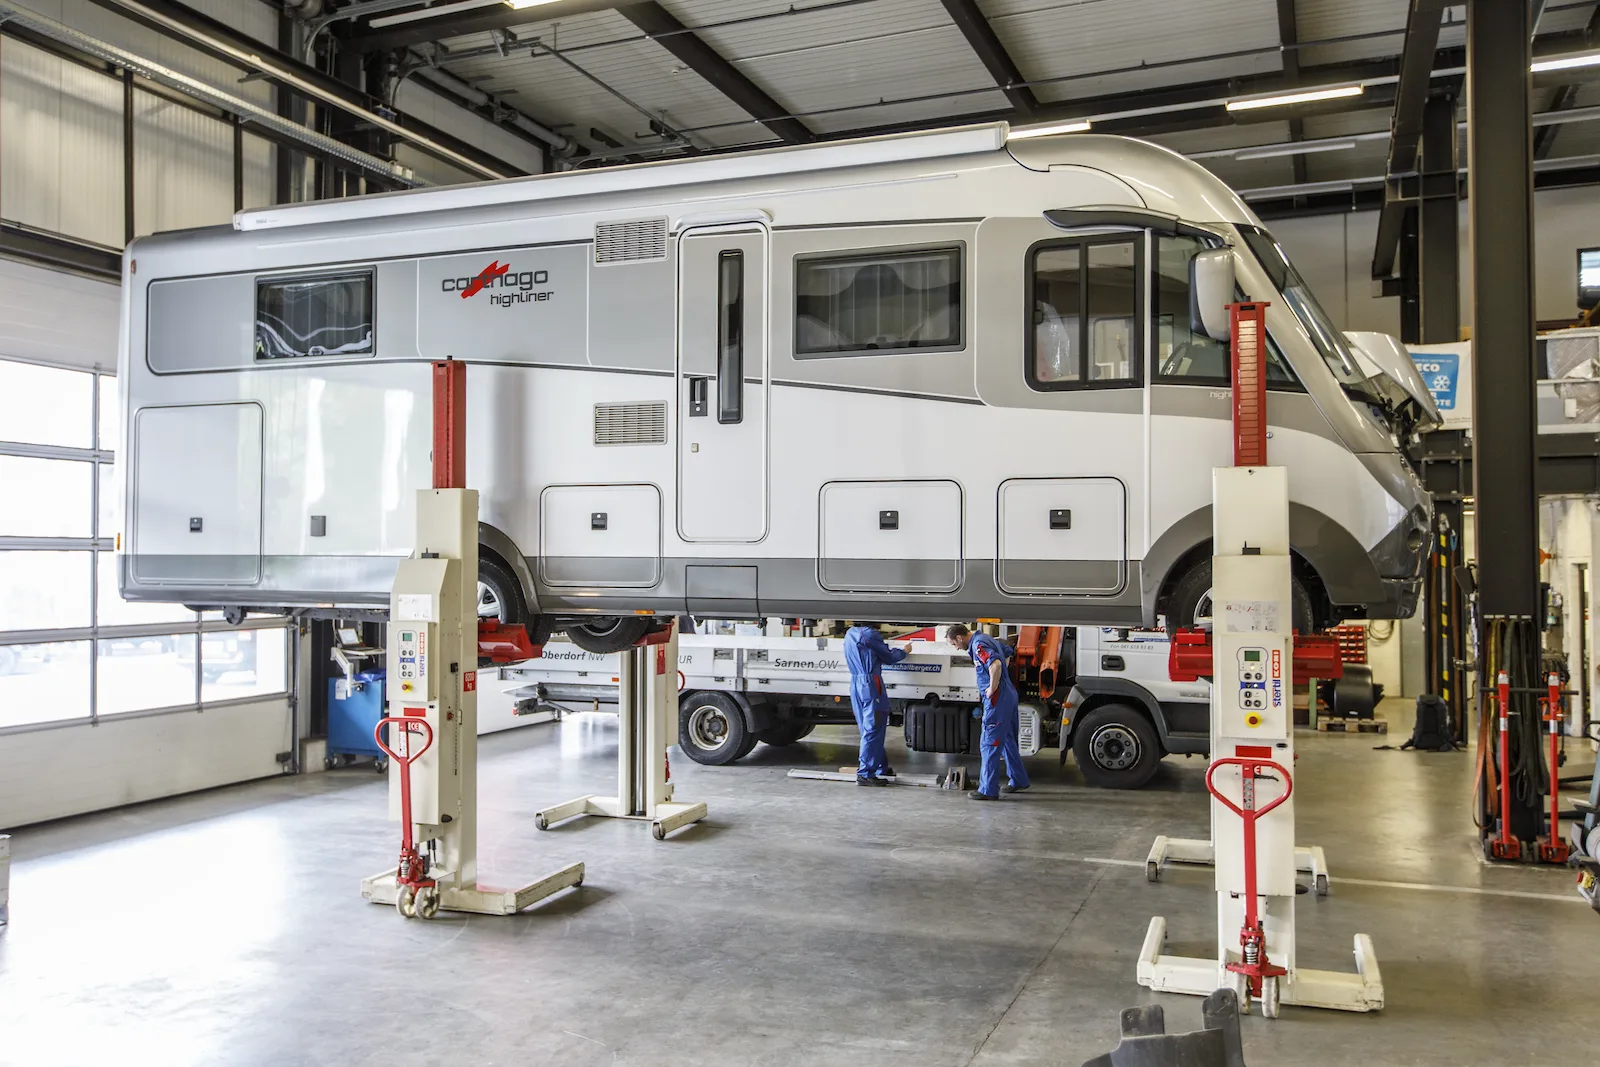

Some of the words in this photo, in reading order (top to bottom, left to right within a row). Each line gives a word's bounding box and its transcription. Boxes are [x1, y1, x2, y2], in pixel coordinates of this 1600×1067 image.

[442, 270, 548, 291] carthago
[490, 291, 554, 307] highliner
[1415, 363, 1440, 372] ECO
[541, 651, 586, 660] Oberdorf
[588, 652, 605, 661] NW
[679, 655, 692, 664] UR
[774, 658, 814, 669] Sarnen
[818, 659, 839, 670] OW
[1272, 650, 1280, 678] KONI
[1272, 680, 1281, 708] stertil
